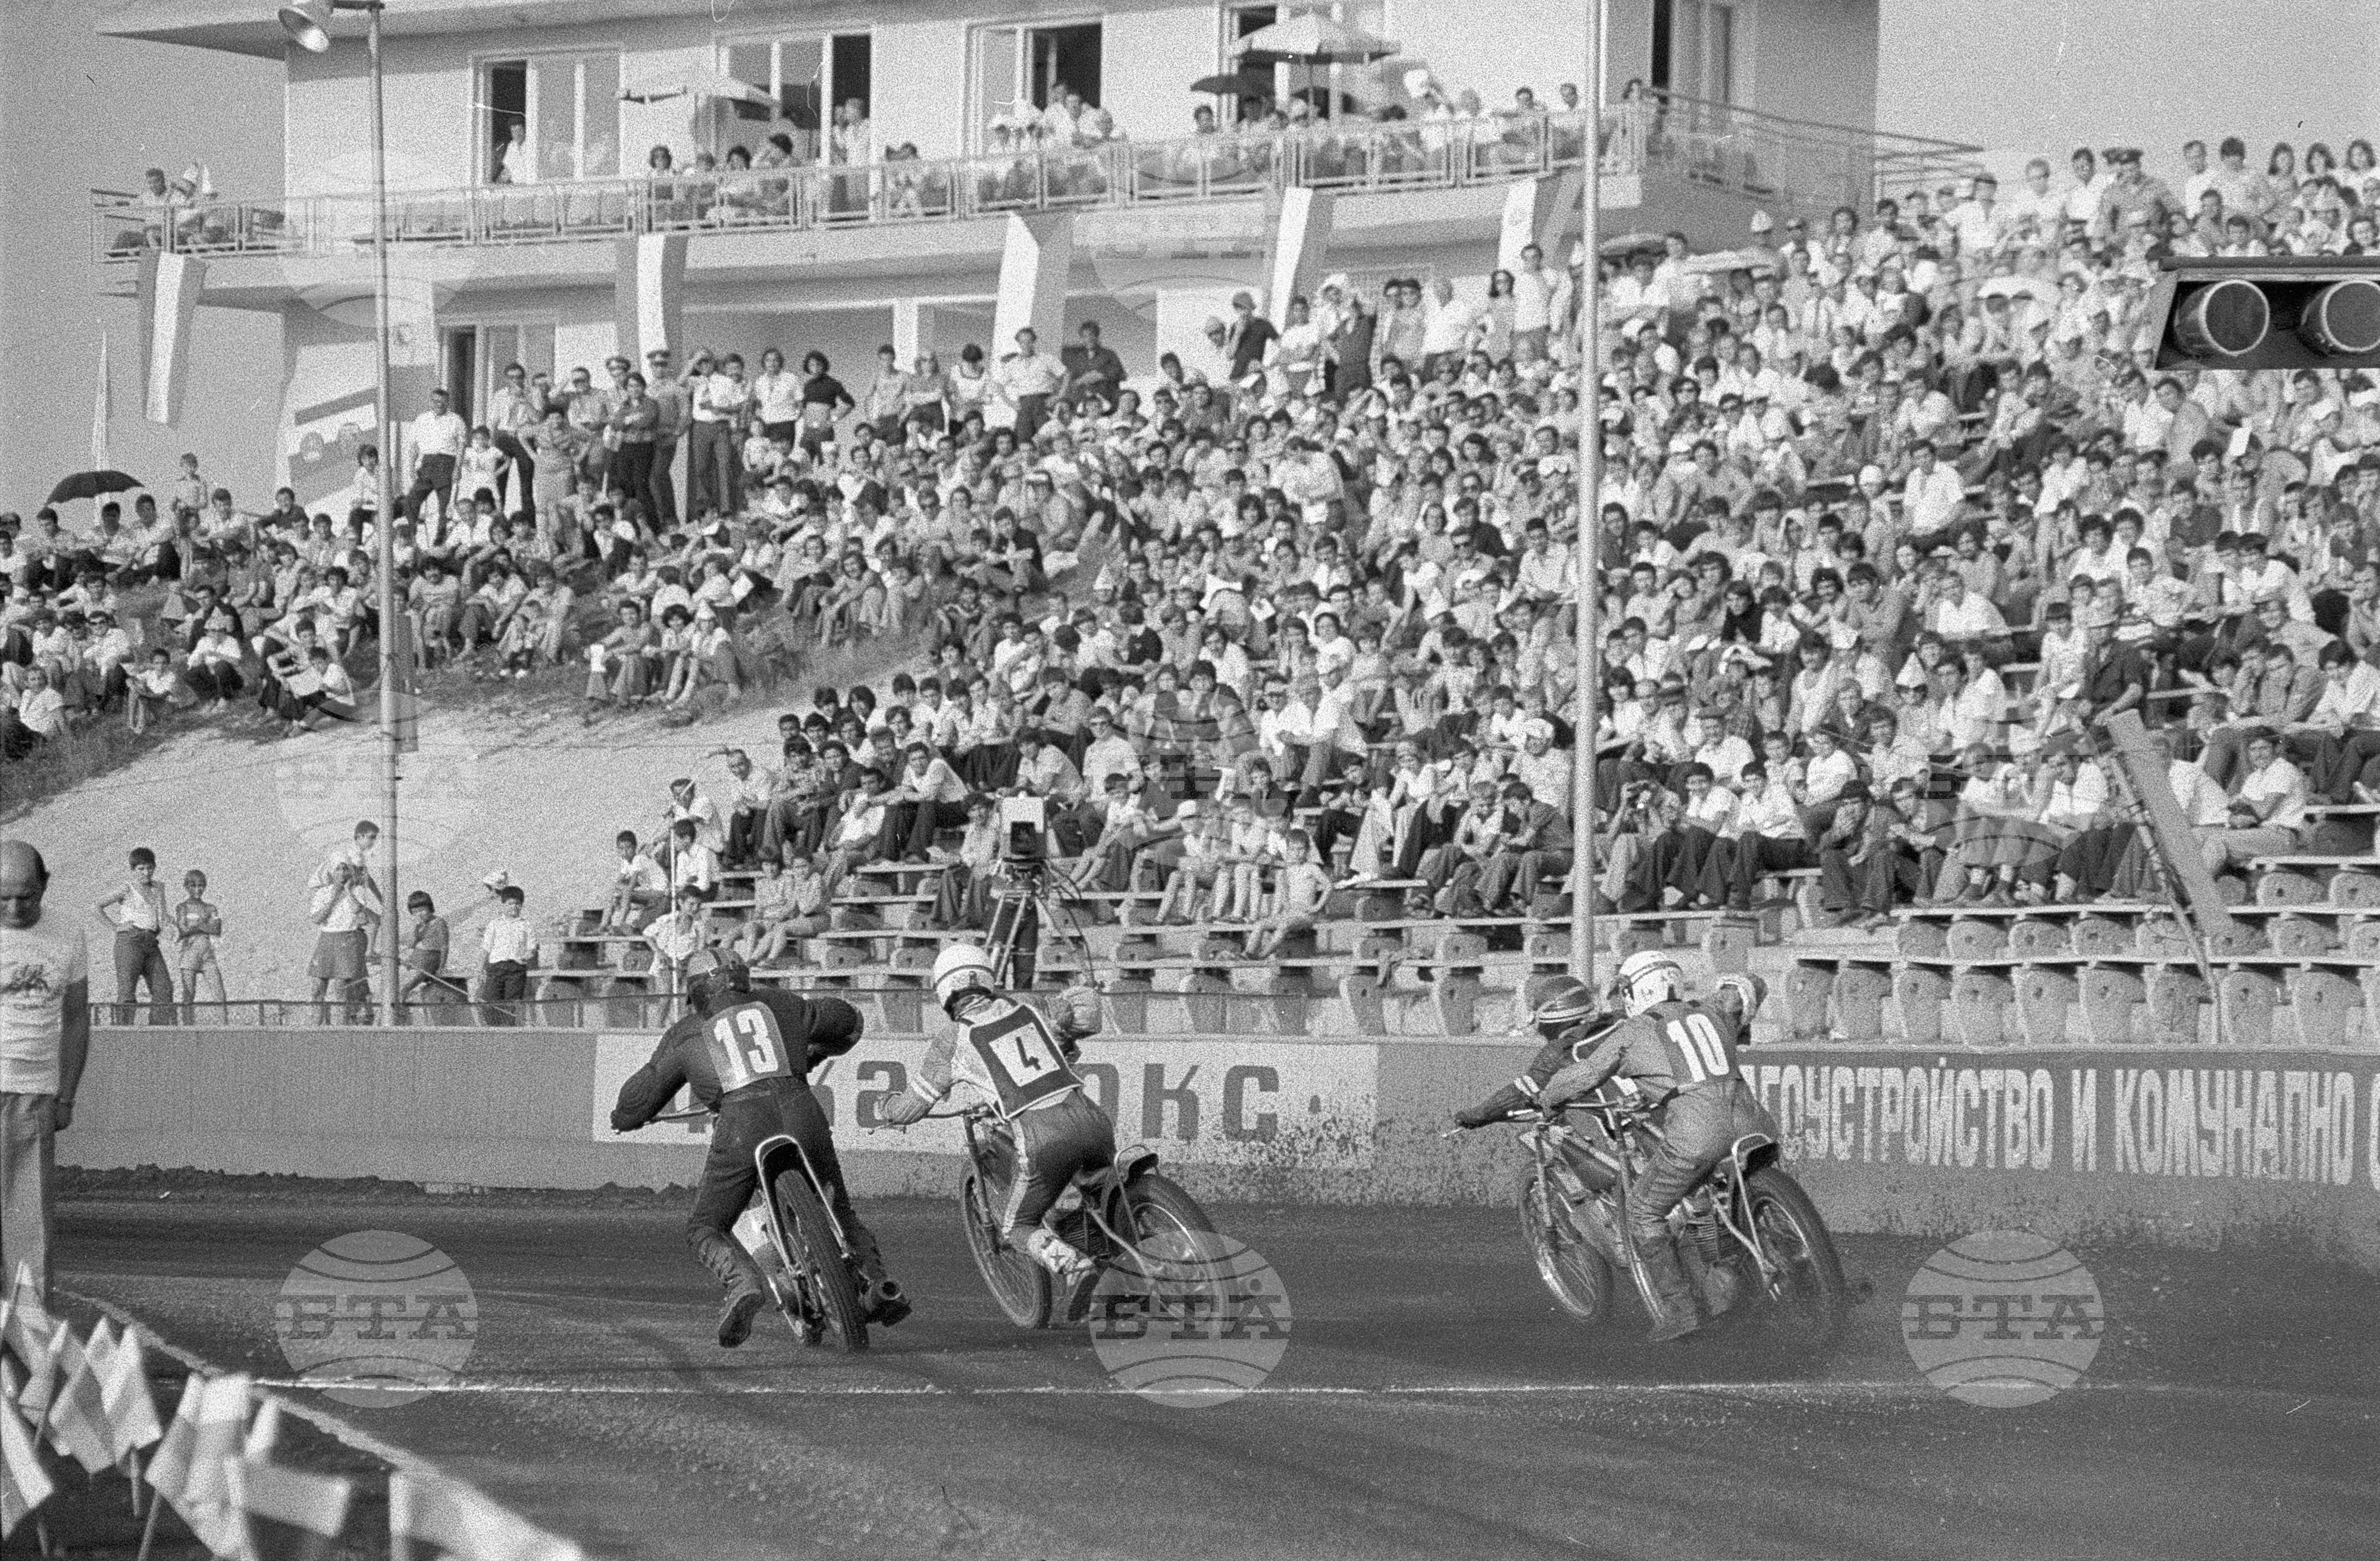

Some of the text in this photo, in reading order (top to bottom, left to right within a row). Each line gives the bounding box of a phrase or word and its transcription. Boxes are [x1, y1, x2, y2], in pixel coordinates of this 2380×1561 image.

[714, 1008, 778, 1082] 13
[1015, 1036, 1042, 1071] 4
[1666, 1013, 1730, 1083] 10
[2071, 1069, 2097, 1173] И
[2115, 1068, 2355, 1185] КОМУНАЛНО
